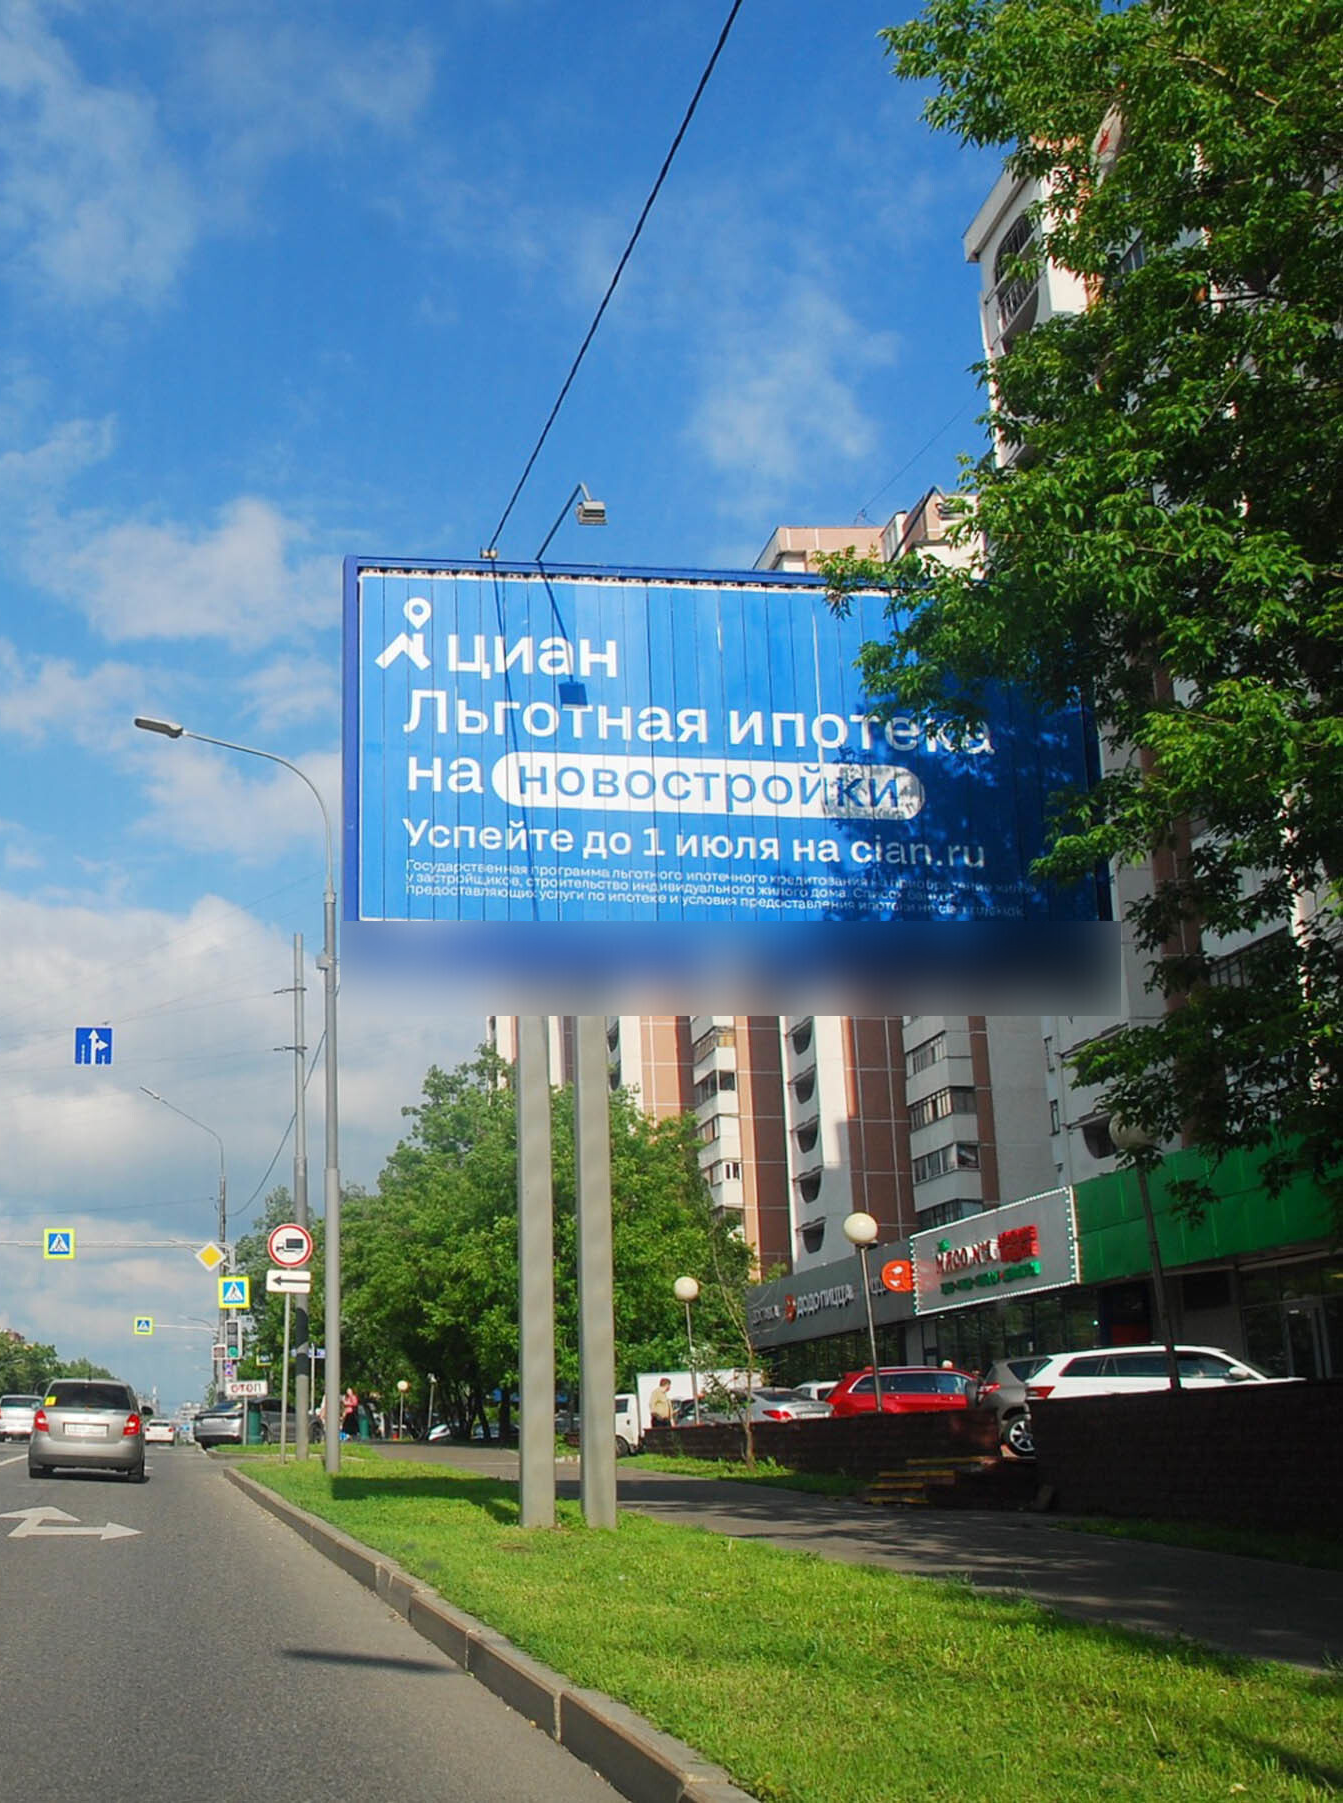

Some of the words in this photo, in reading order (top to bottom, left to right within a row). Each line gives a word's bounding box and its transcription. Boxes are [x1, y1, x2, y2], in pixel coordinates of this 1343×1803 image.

[447, 634, 618, 680] циан
[403, 689, 709, 744] Льготная
[729, 710, 996, 755] ипотека
[407, 757, 485, 794] на
[518, 764, 899, 812] новостройки
[402, 817, 574, 853] Успейте
[582, 829, 633, 860] до
[643, 827, 666, 857] 1
[675, 833, 781, 862] июля
[793, 838, 840, 863] на
[850, 834, 986, 868] cian.ru
[531, 863, 610, 878] программа
[588, 891, 605, 902] по
